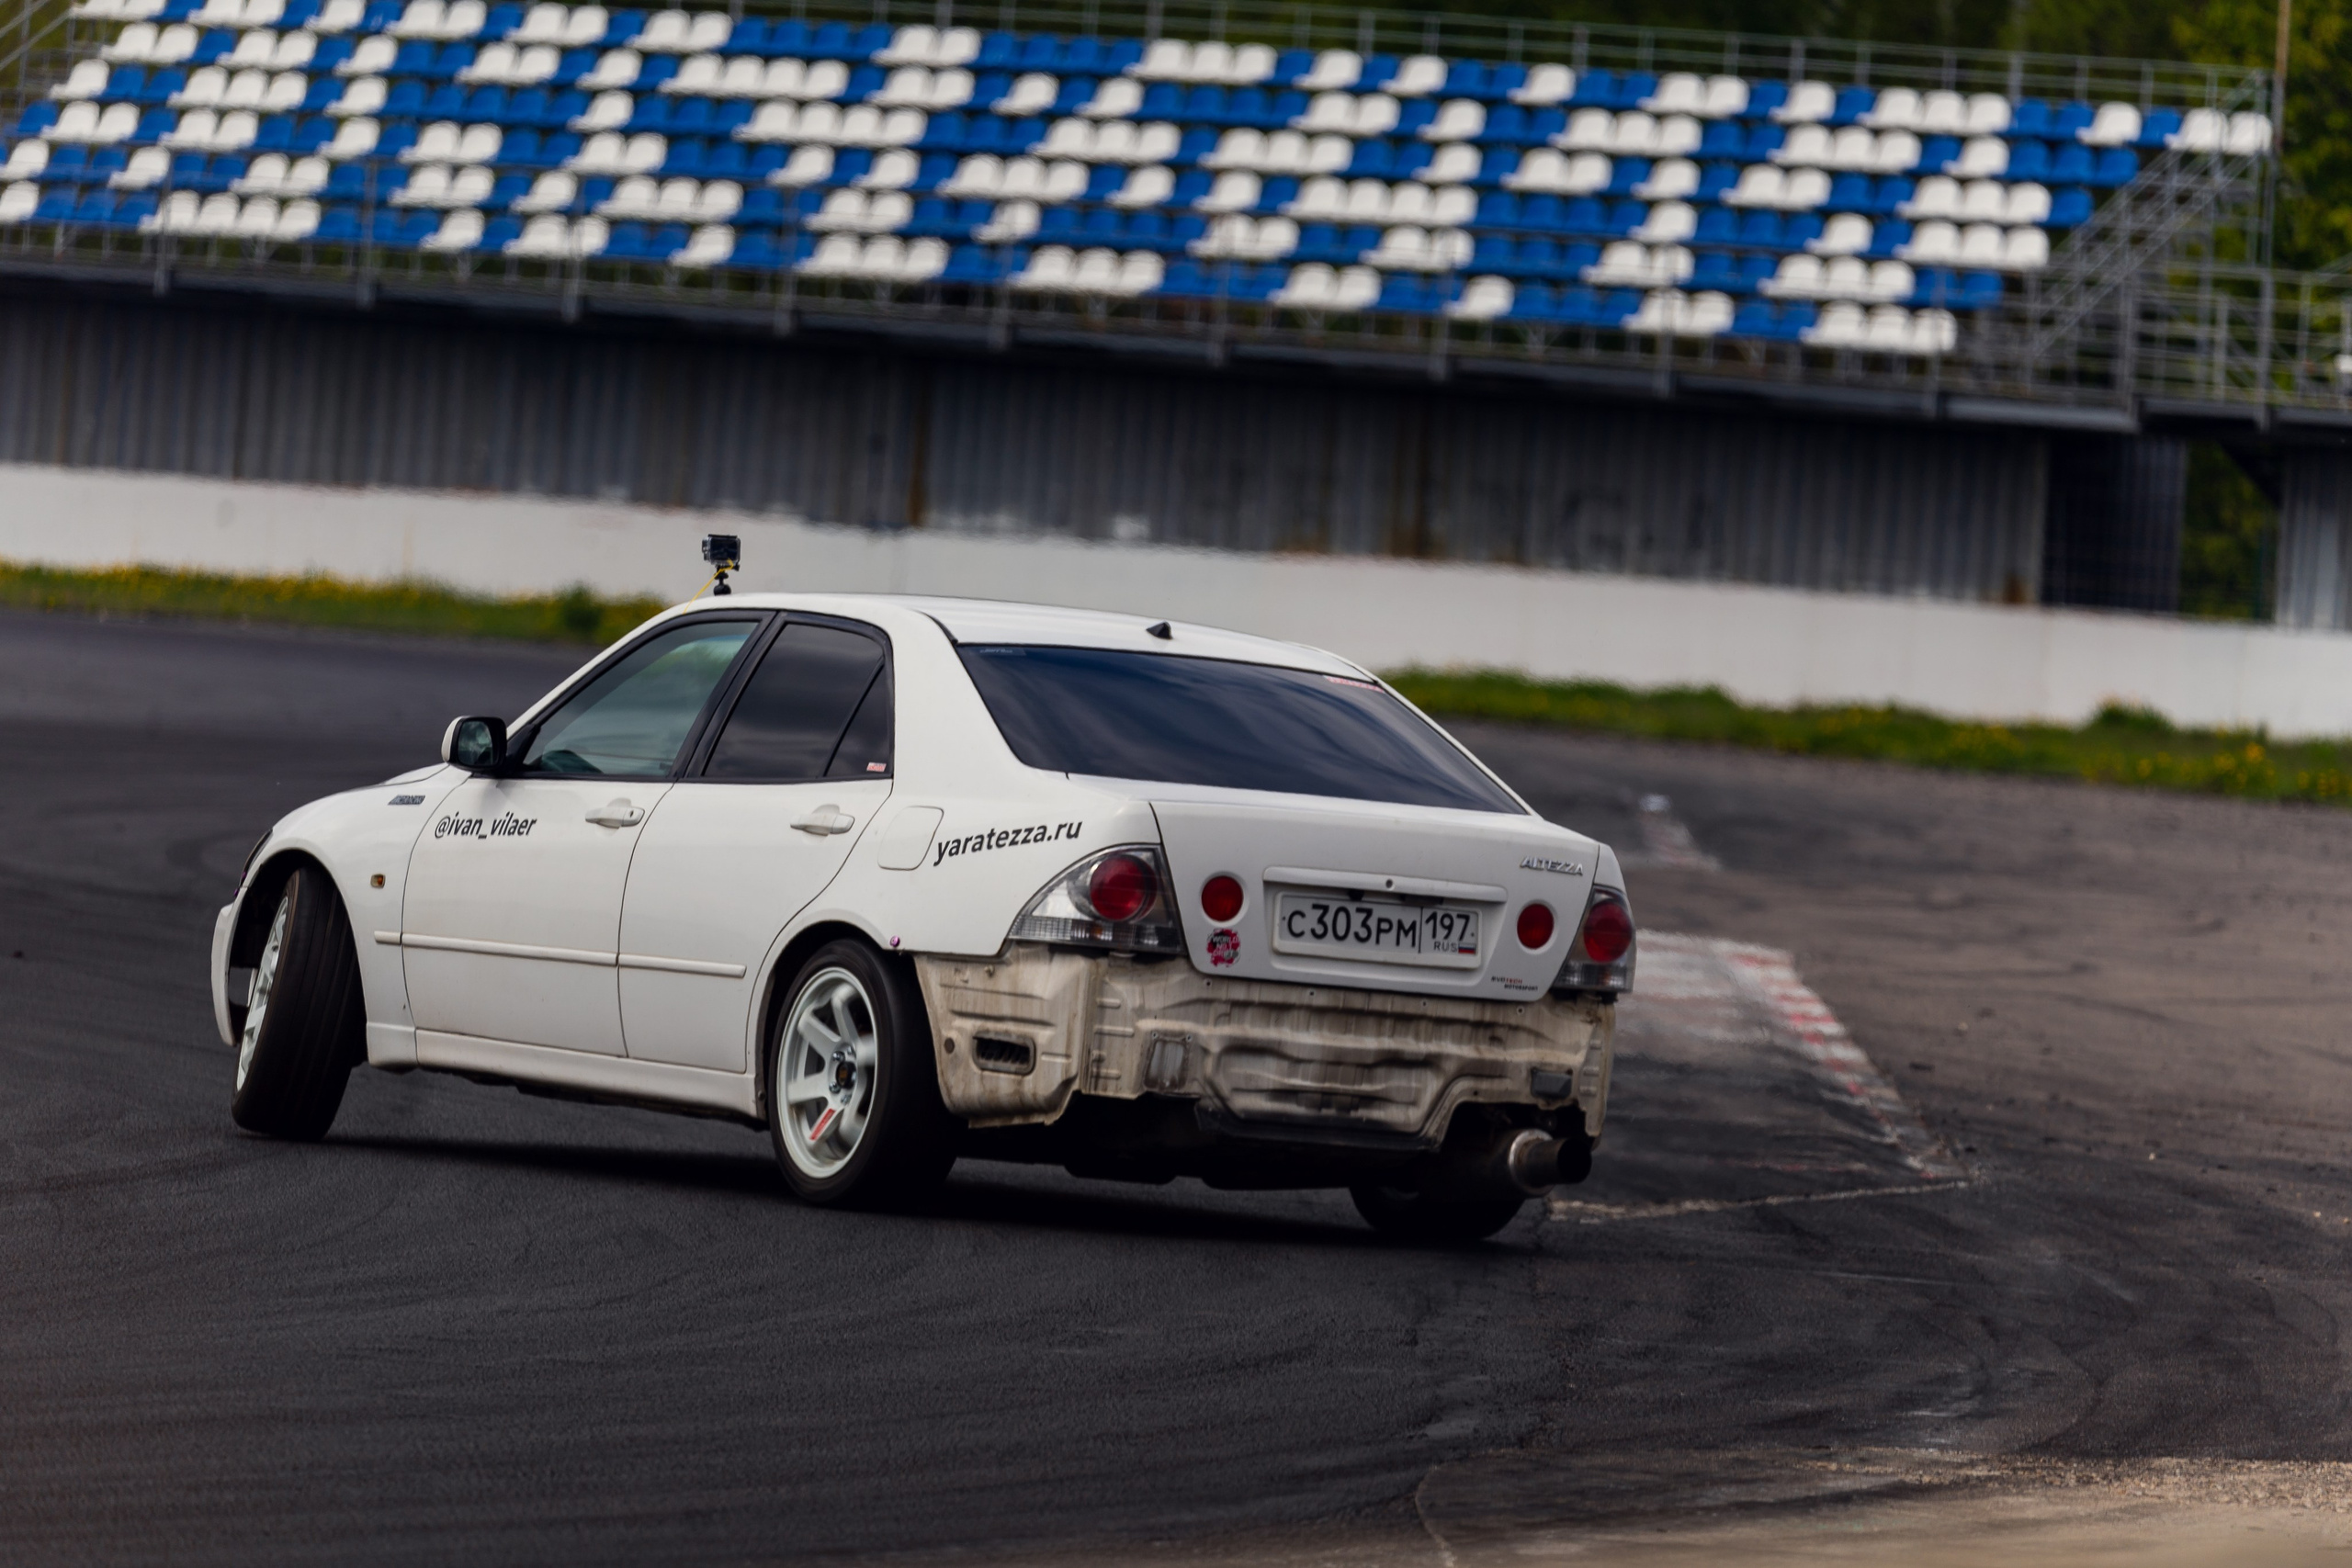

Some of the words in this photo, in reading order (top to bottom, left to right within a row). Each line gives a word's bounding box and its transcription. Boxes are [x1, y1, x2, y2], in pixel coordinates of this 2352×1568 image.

[435, 811, 537, 840] @ivan_vilaer
[933, 821, 1082, 866] yaratezza.ru
[1520, 855, 1583, 875] ALTEZZA
[1425, 910, 1470, 942] 197
[1433, 941, 1458, 953] RUS
